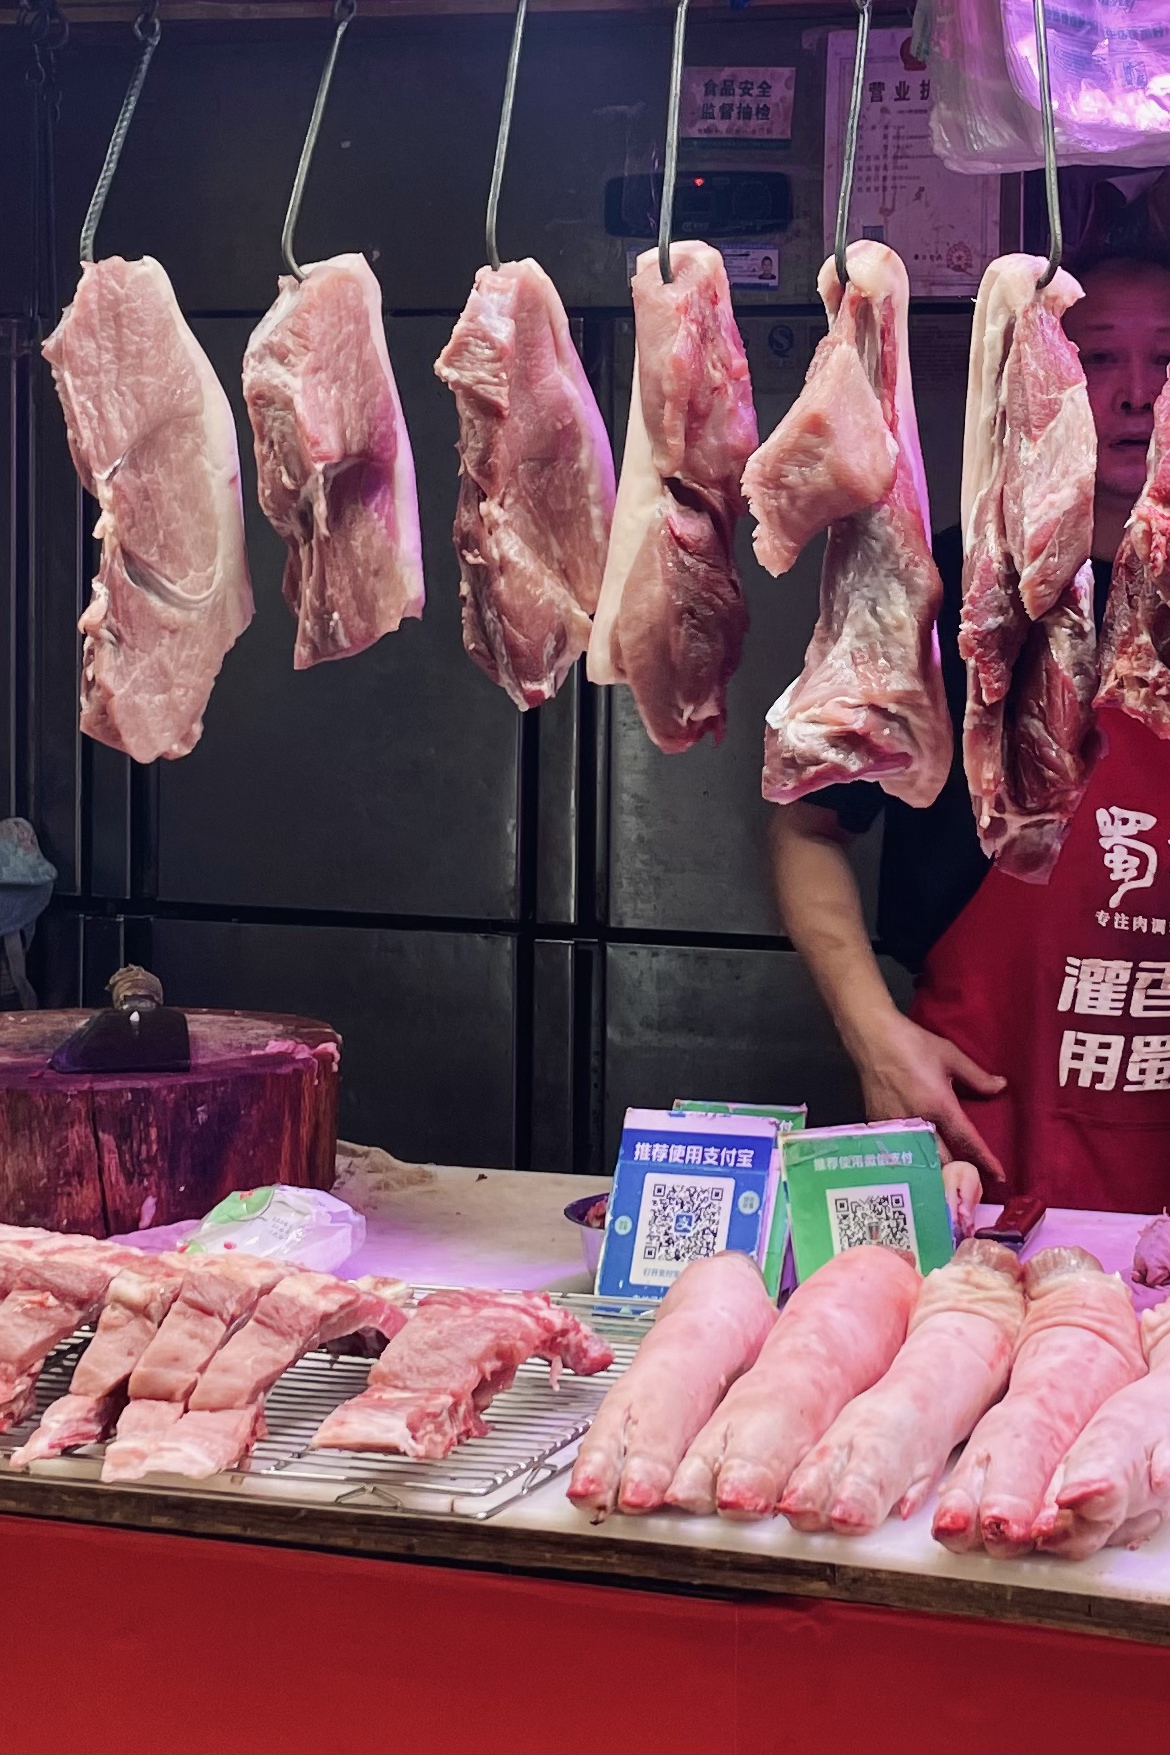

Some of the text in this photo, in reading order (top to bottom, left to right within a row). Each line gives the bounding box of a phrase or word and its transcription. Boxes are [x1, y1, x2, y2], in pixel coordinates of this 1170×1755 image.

[703, 79, 772, 97] 食品安全
[700, 102, 771, 120] 监督抽检
[634, 1141, 755, 1168] 推荐使用支付宝
